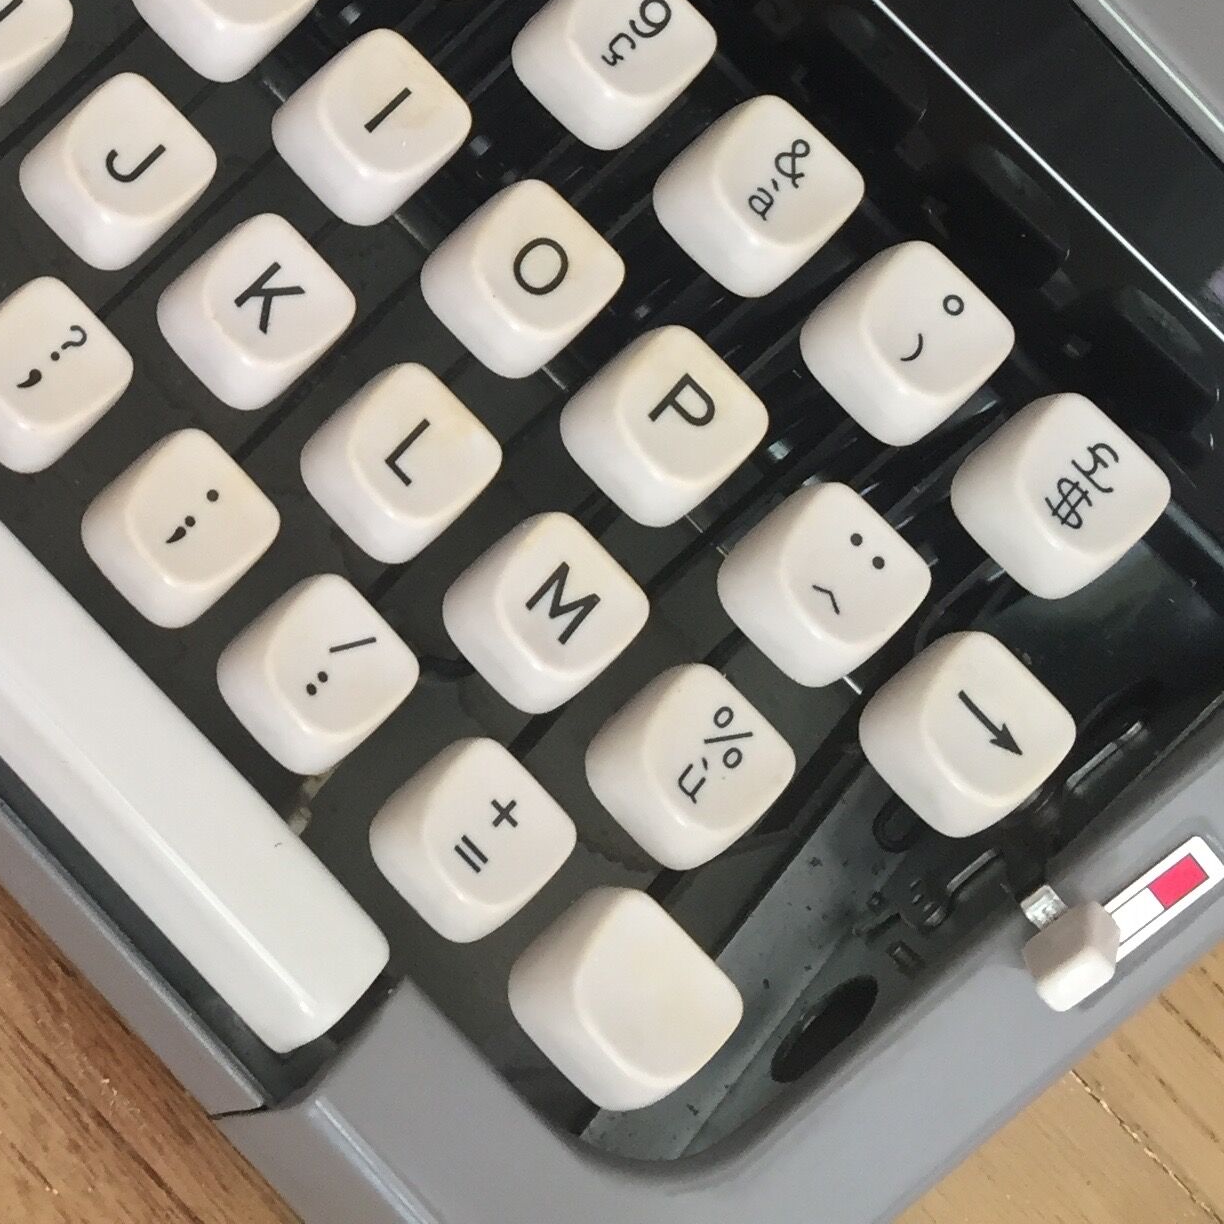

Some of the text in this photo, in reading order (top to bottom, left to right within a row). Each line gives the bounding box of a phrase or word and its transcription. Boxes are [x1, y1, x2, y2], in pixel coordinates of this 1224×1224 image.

[106, 145, 166, 183] J
[774, 139, 810, 189] &
[234, 262, 305, 334] K
[51, 325, 87, 361] ?
[648, 373, 715, 426] P
[385, 419, 430, 486] L
[526, 562, 600, 645] M
[703, 706, 754, 769] %
[491, 800, 518, 827] +
